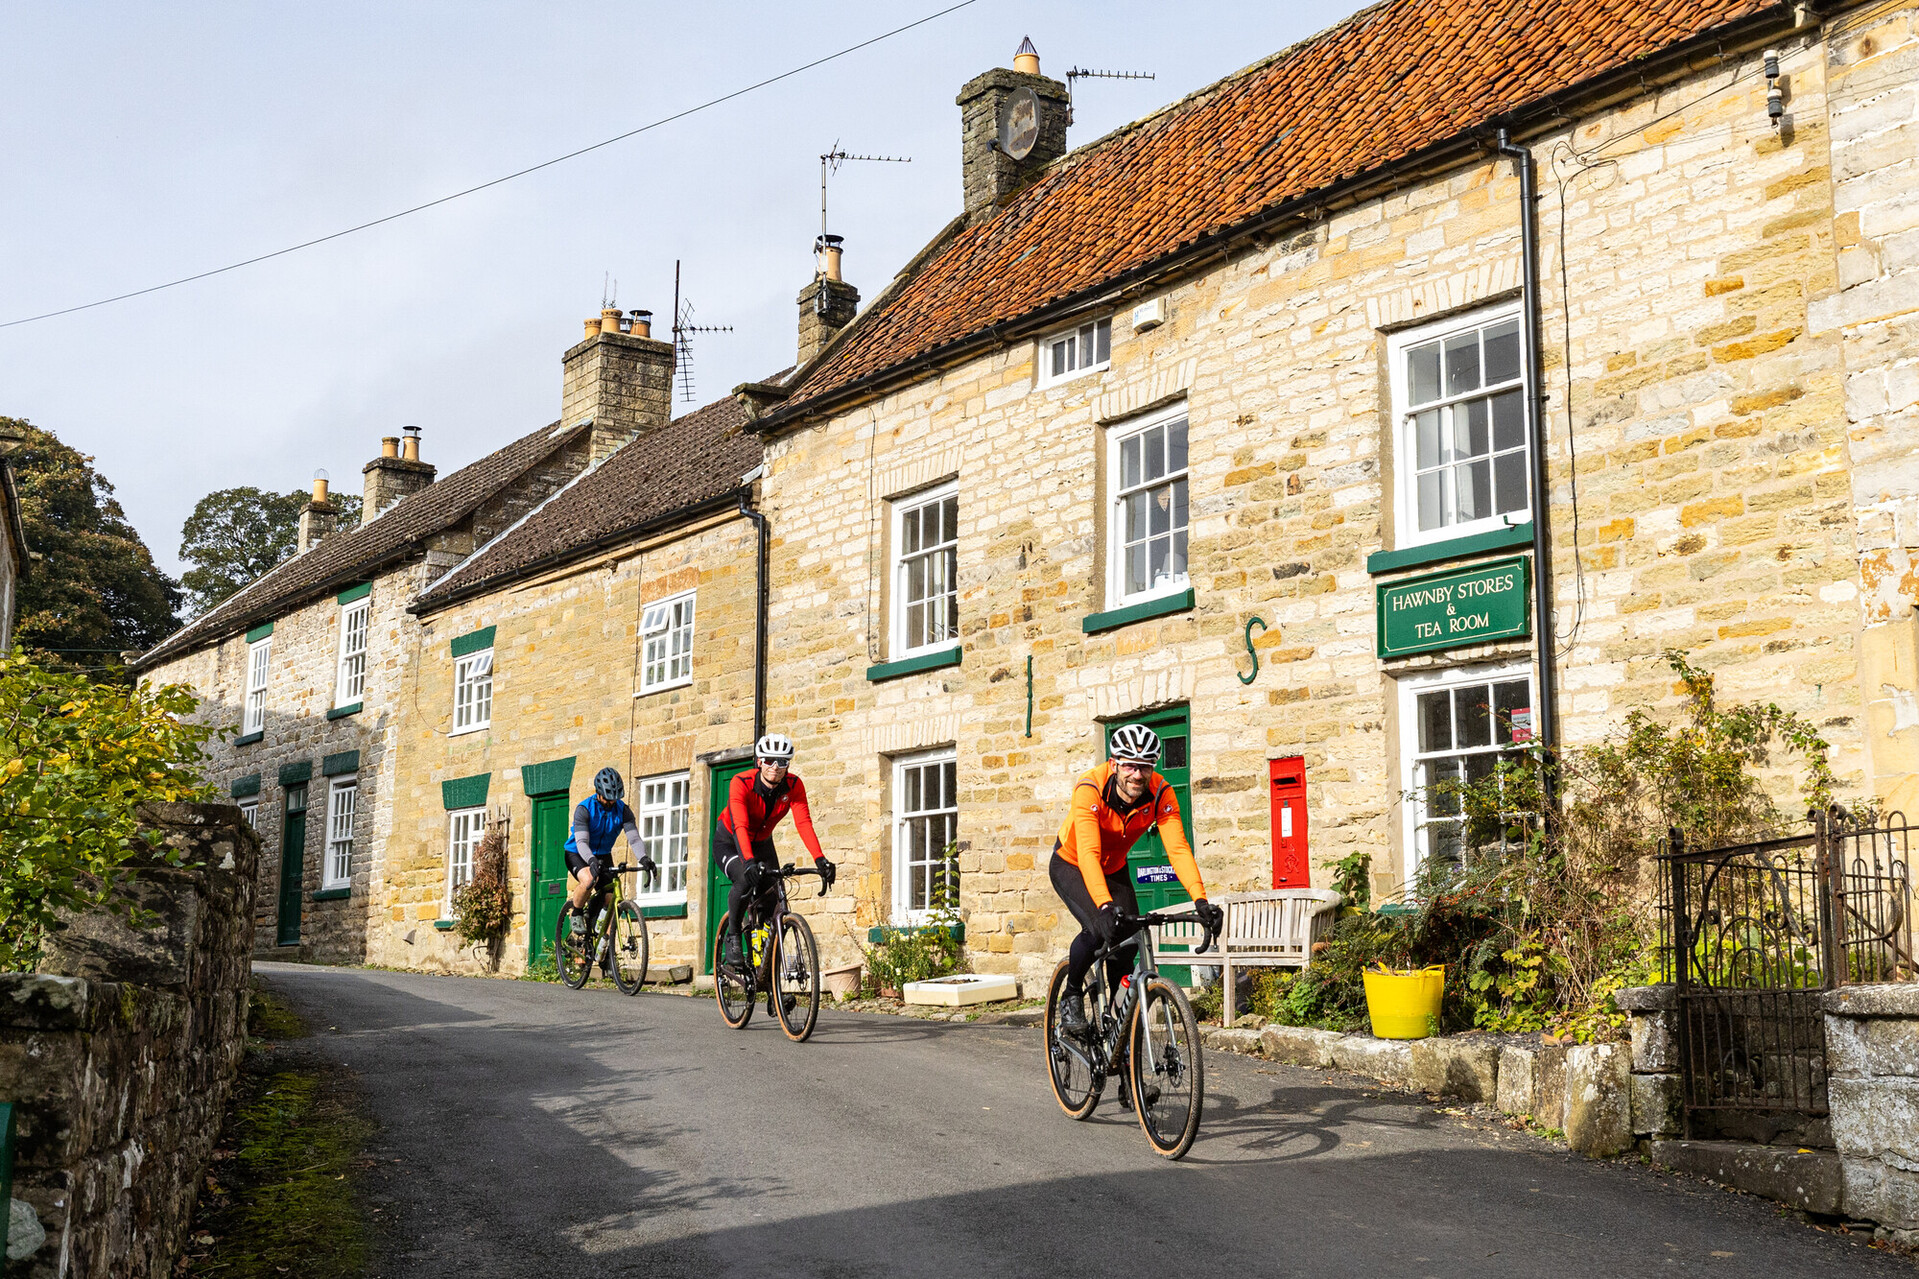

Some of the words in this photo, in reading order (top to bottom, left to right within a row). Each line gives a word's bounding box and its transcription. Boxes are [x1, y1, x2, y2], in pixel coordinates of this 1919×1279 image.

[1393, 586, 1454, 611] HAWNBY
[1458, 575, 1513, 598] STORES
[1446, 603, 1457, 616] &
[1415, 621, 1442, 638] TEA
[1449, 612, 1489, 633] ROOM
[1150, 874, 1168, 882] TIMES
